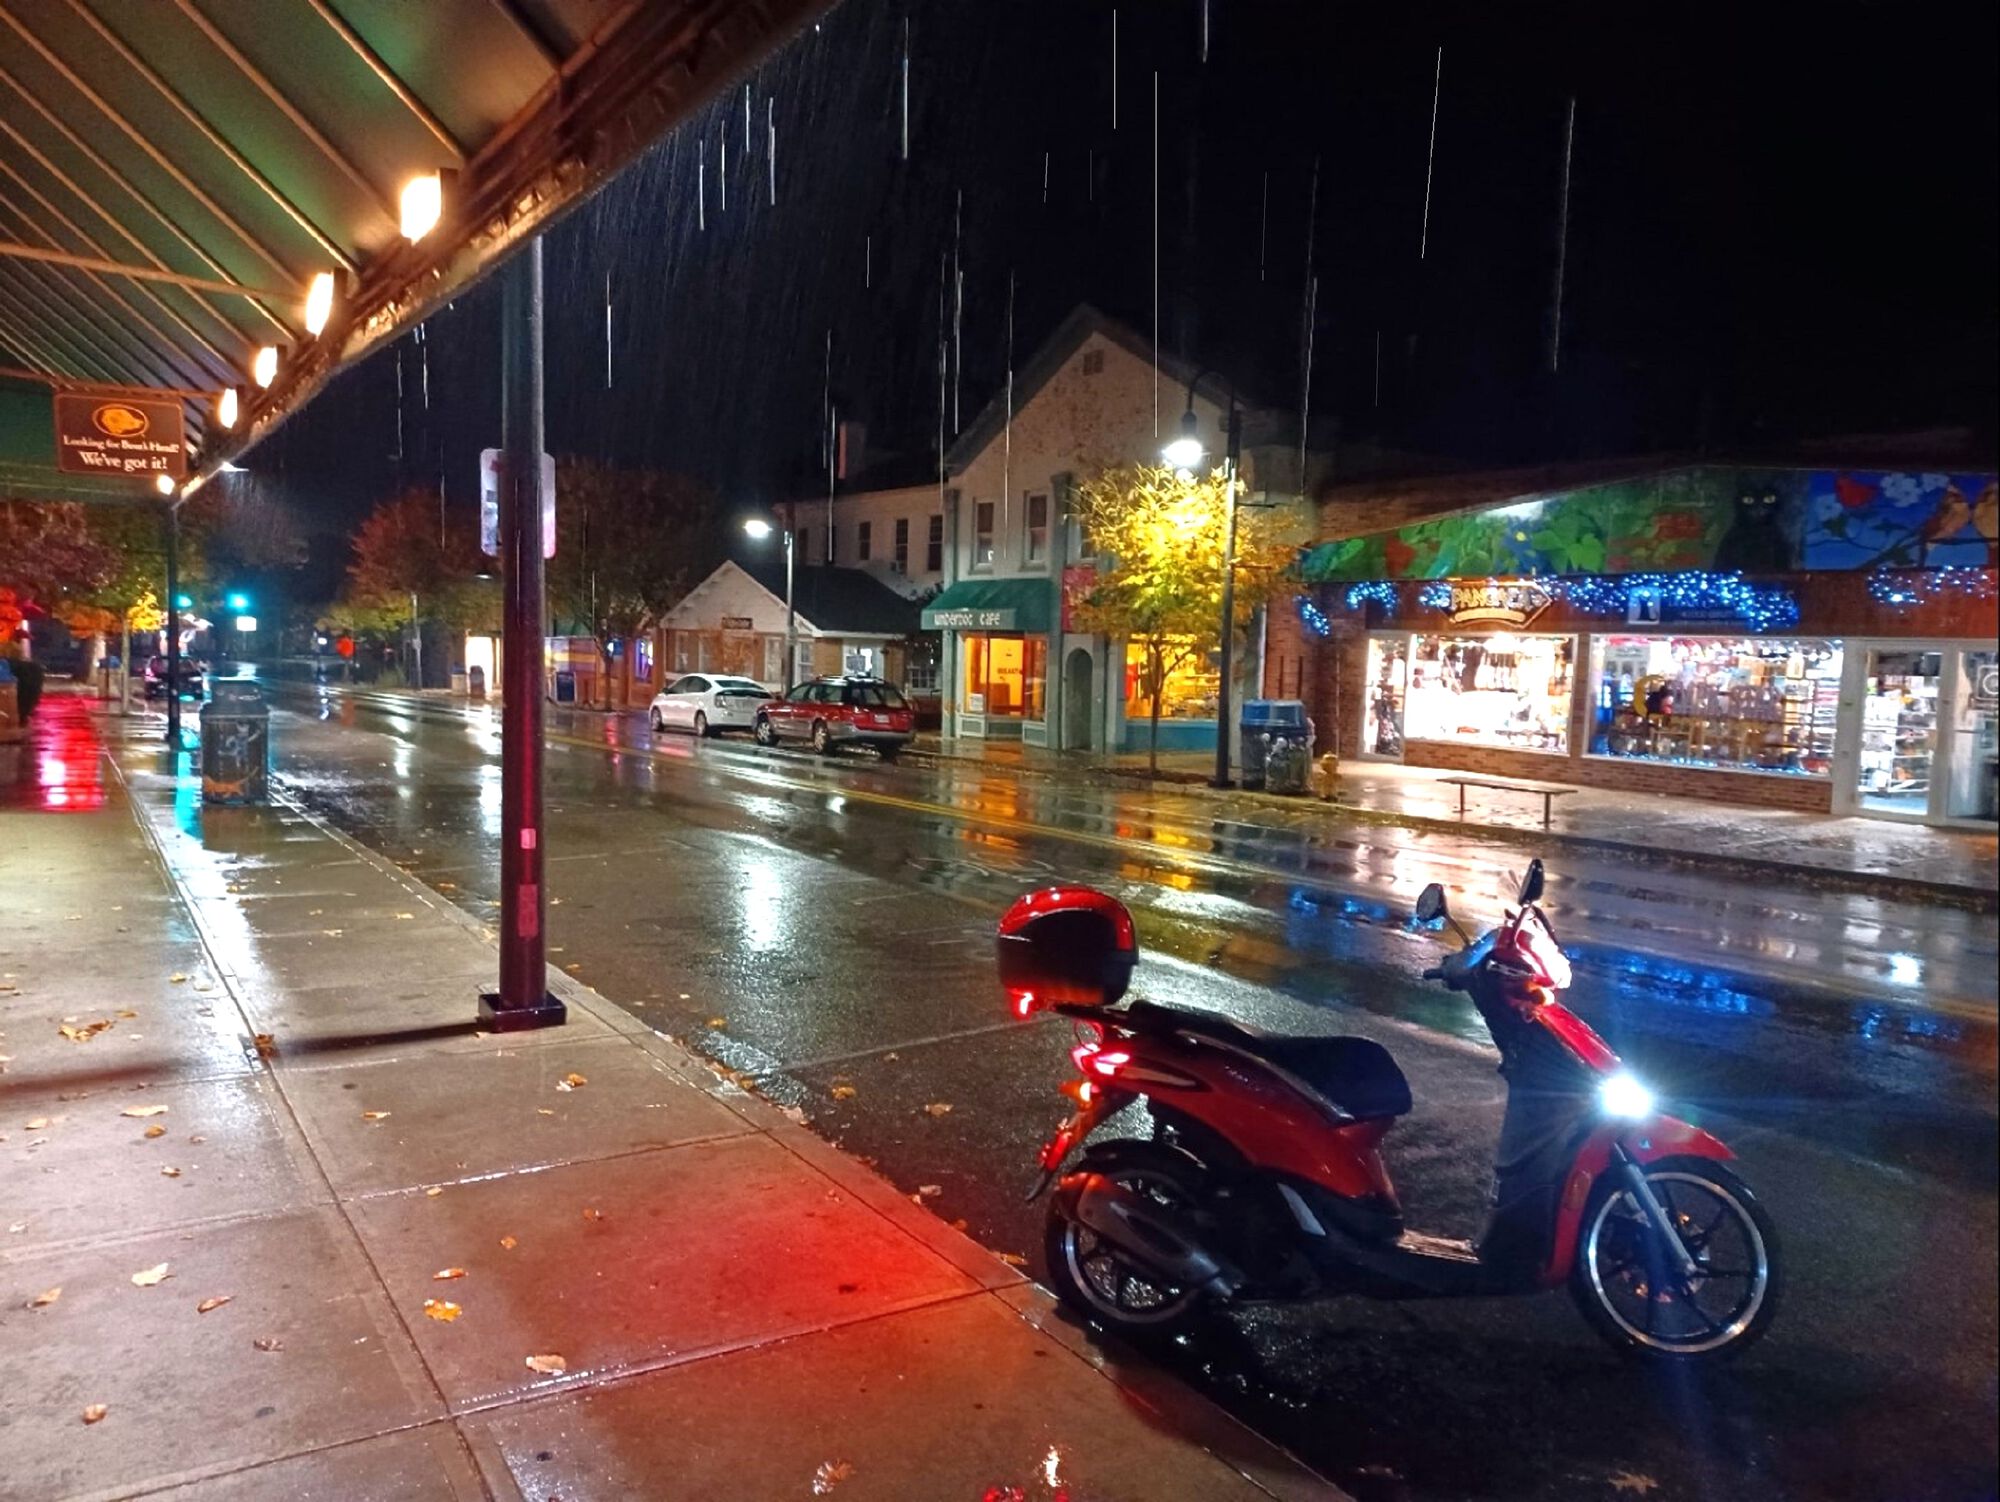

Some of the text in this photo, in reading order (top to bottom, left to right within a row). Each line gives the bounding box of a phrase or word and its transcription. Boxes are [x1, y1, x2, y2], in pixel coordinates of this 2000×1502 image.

[63, 435, 106, 450] Looking
[105, 439, 120, 449] for
[79, 451, 168, 472] We've got it!
